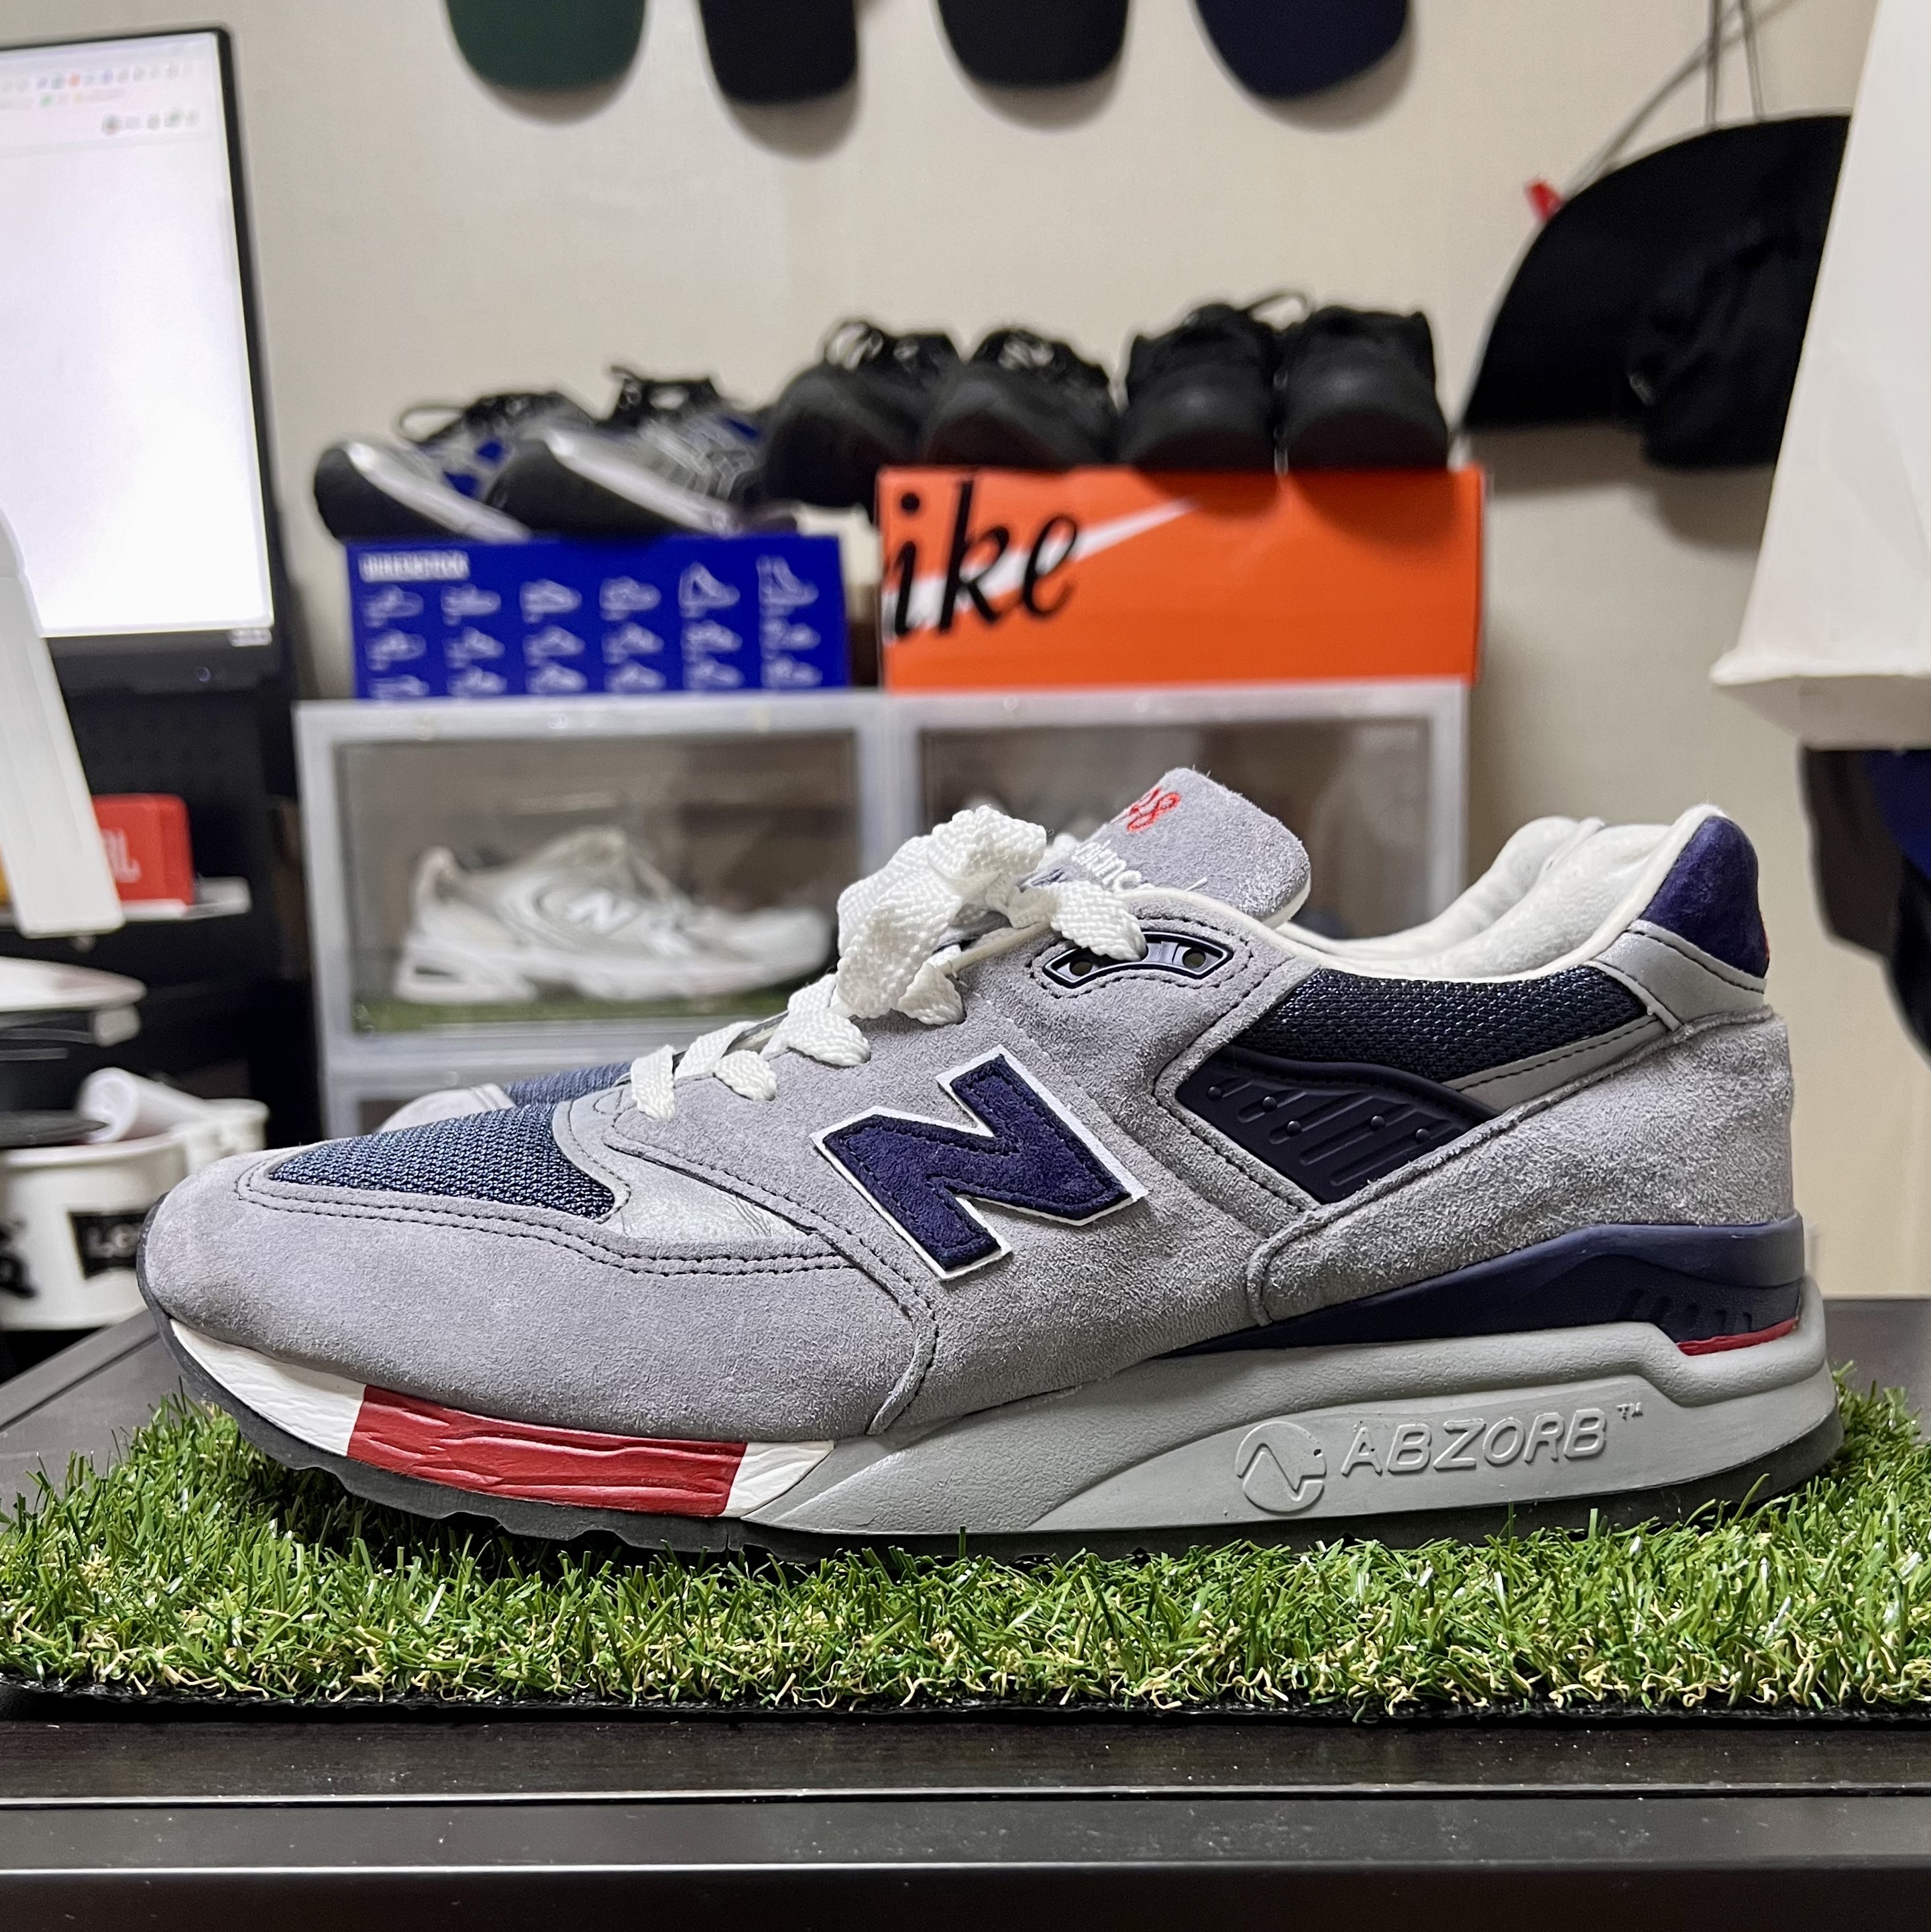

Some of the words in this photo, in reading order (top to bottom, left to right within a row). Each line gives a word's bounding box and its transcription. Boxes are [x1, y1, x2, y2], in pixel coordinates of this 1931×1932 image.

[893, 479, 1079, 637] ike
[810, 1049, 1149, 1281] N
[1341, 1407, 1607, 1476] ABZORB
